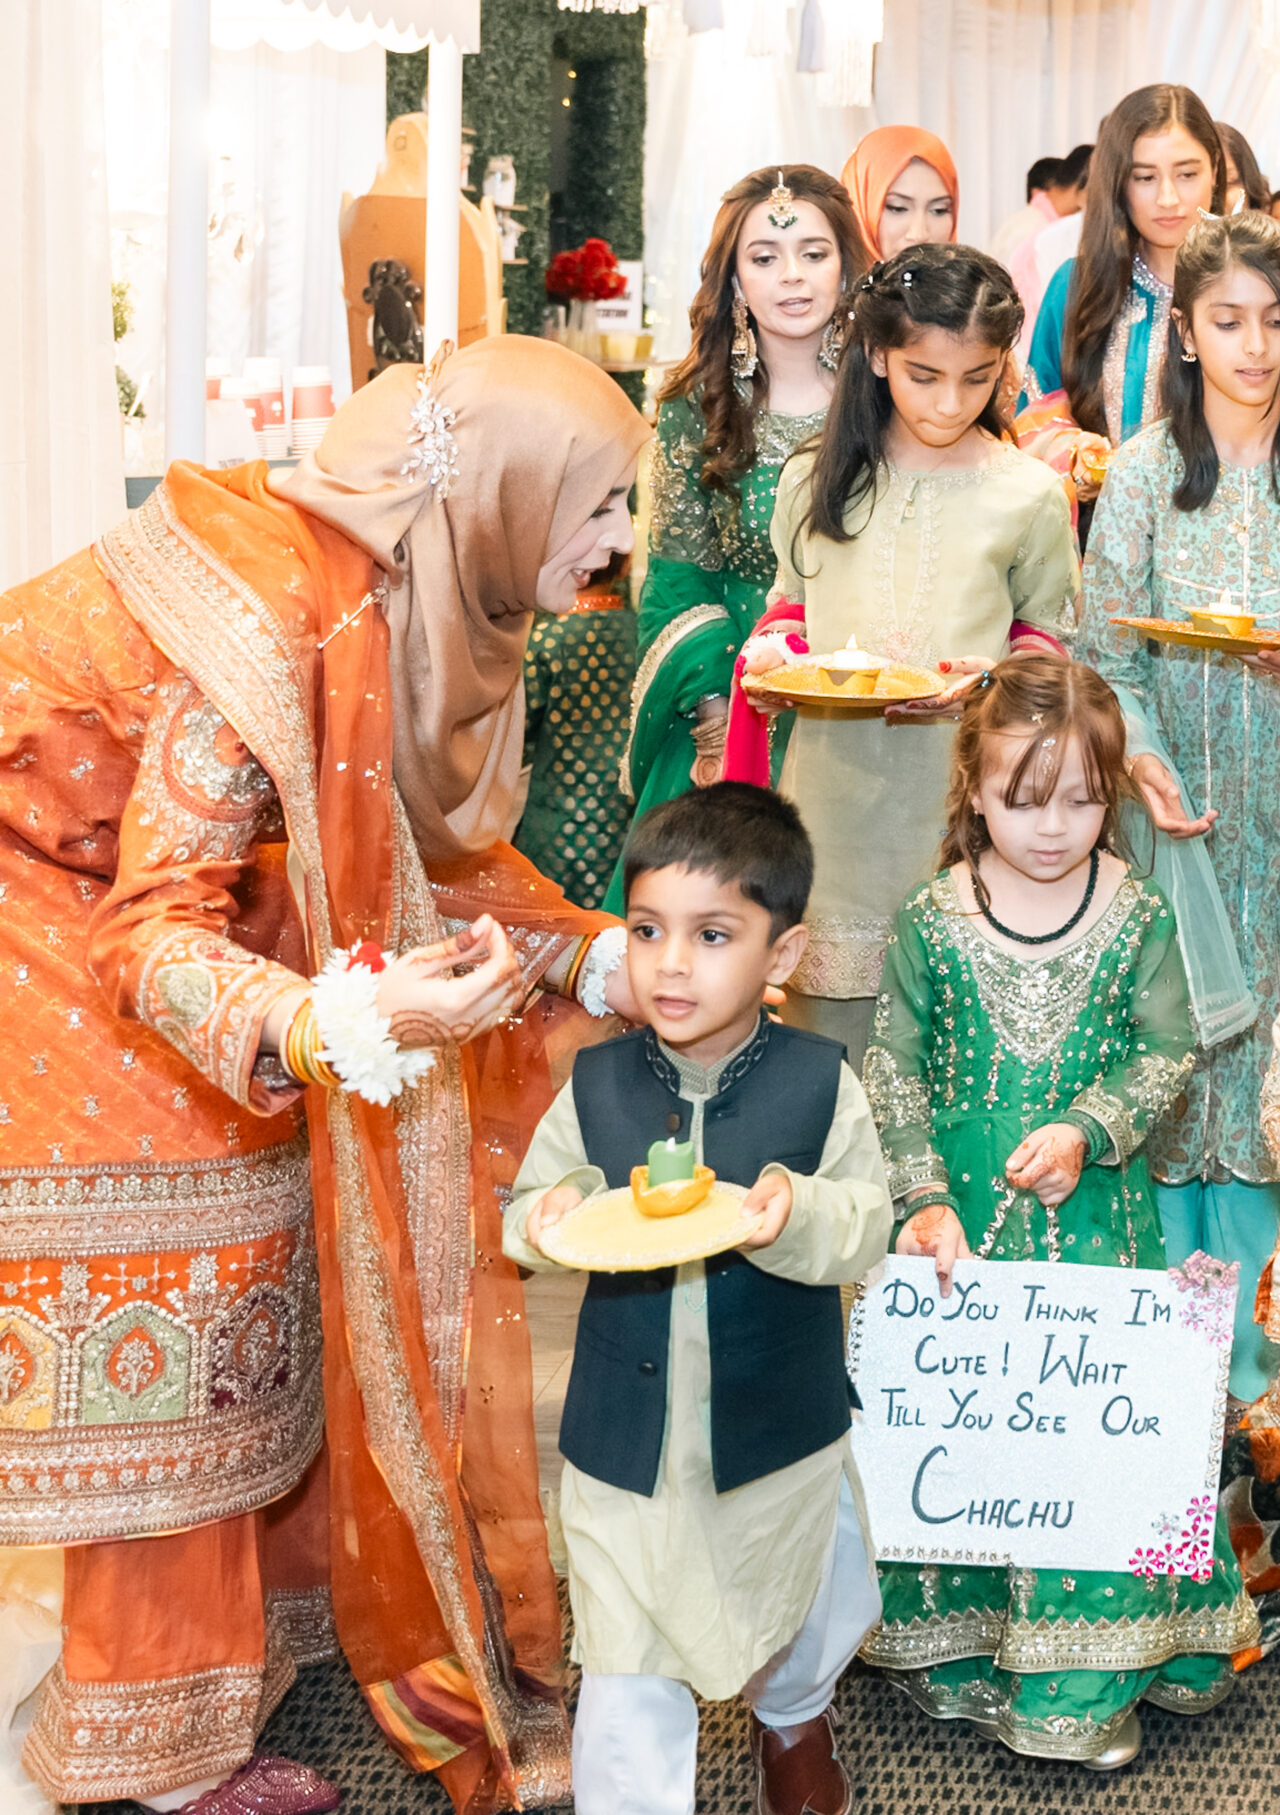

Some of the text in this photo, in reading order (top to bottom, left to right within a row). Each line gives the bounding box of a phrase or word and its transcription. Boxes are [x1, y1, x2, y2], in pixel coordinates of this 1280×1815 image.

[941, 1281, 1000, 1321] YOU
[1023, 1284, 1098, 1324] THINK
[1124, 1288, 1171, 1326] I'M
[1039, 1333, 1128, 1387] WAIT
[880, 1387, 1161, 1436] TILL YOU SEE OUR
[911, 1444, 1075, 1529] CHACHU
